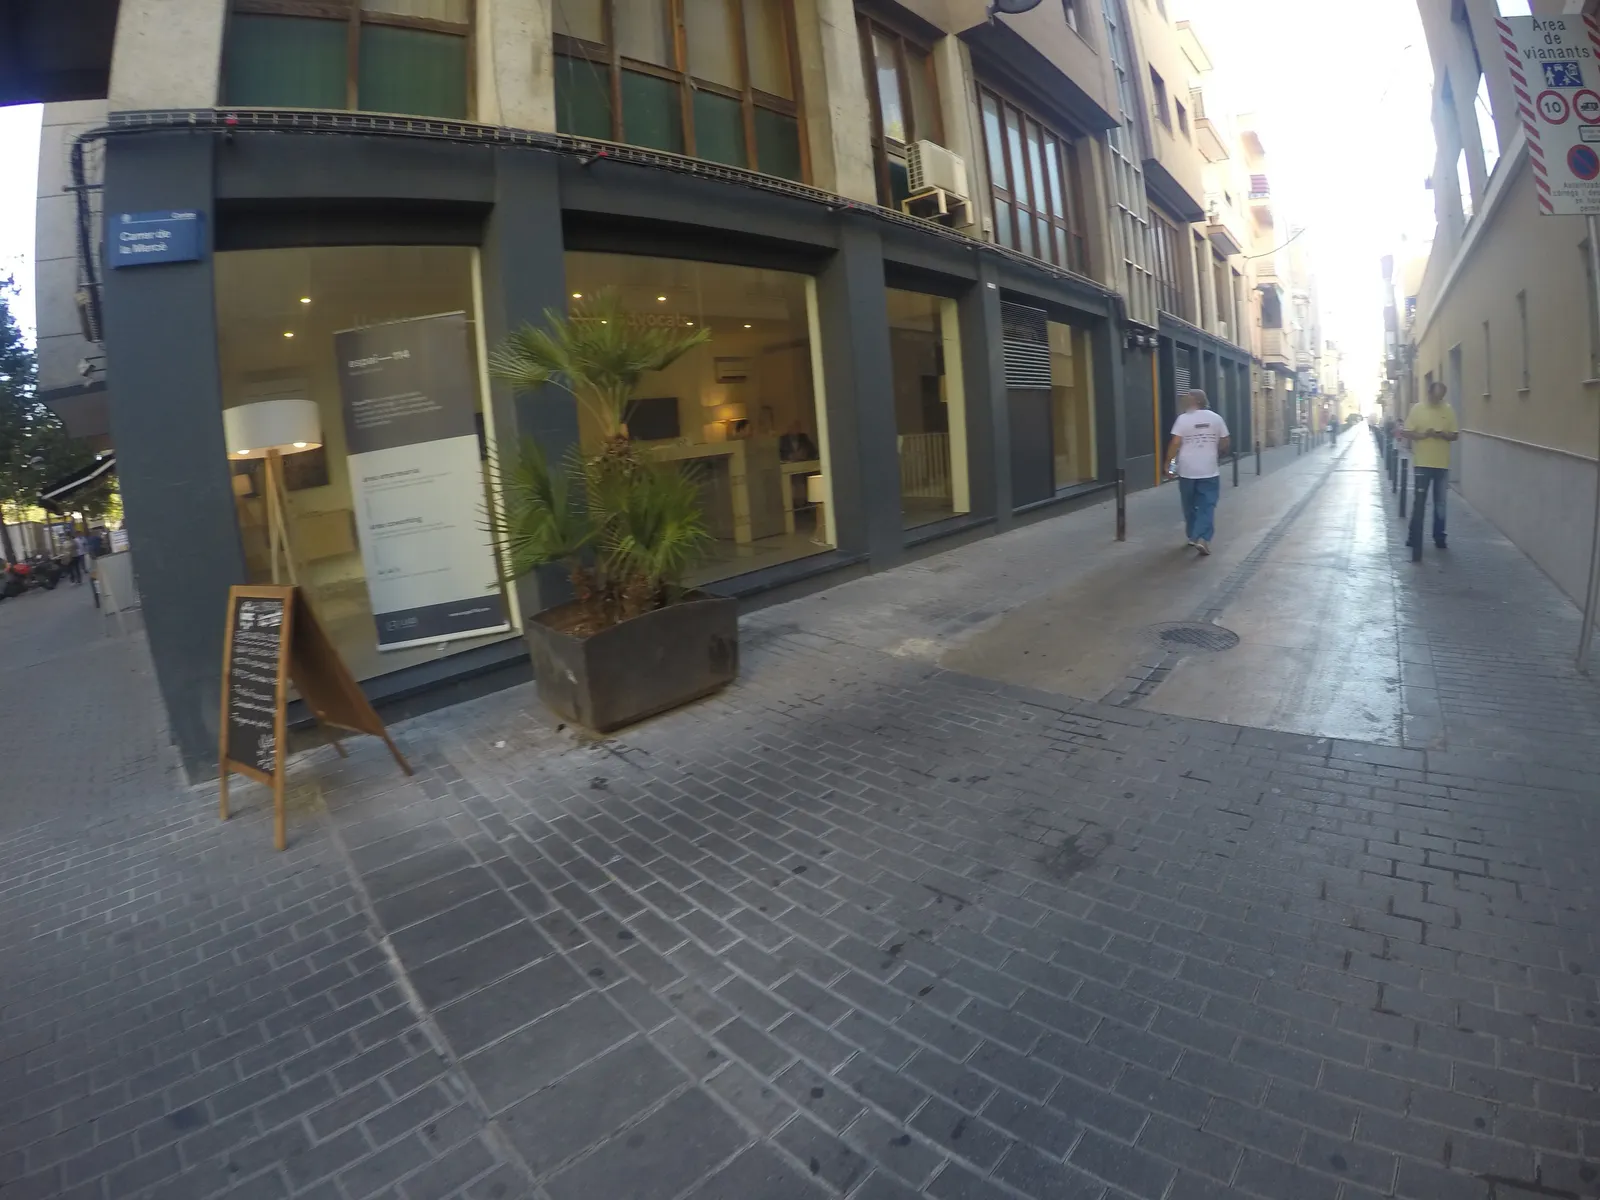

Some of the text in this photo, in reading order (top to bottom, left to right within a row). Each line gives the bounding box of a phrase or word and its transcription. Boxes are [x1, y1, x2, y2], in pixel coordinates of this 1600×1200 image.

[1544, 32, 1562, 45] de
[1523, 46, 1590, 59] vianants
[1544, 101, 1562, 114] 10
[119, 229, 171, 241] Carrer de
[119, 244, 132, 254] la
